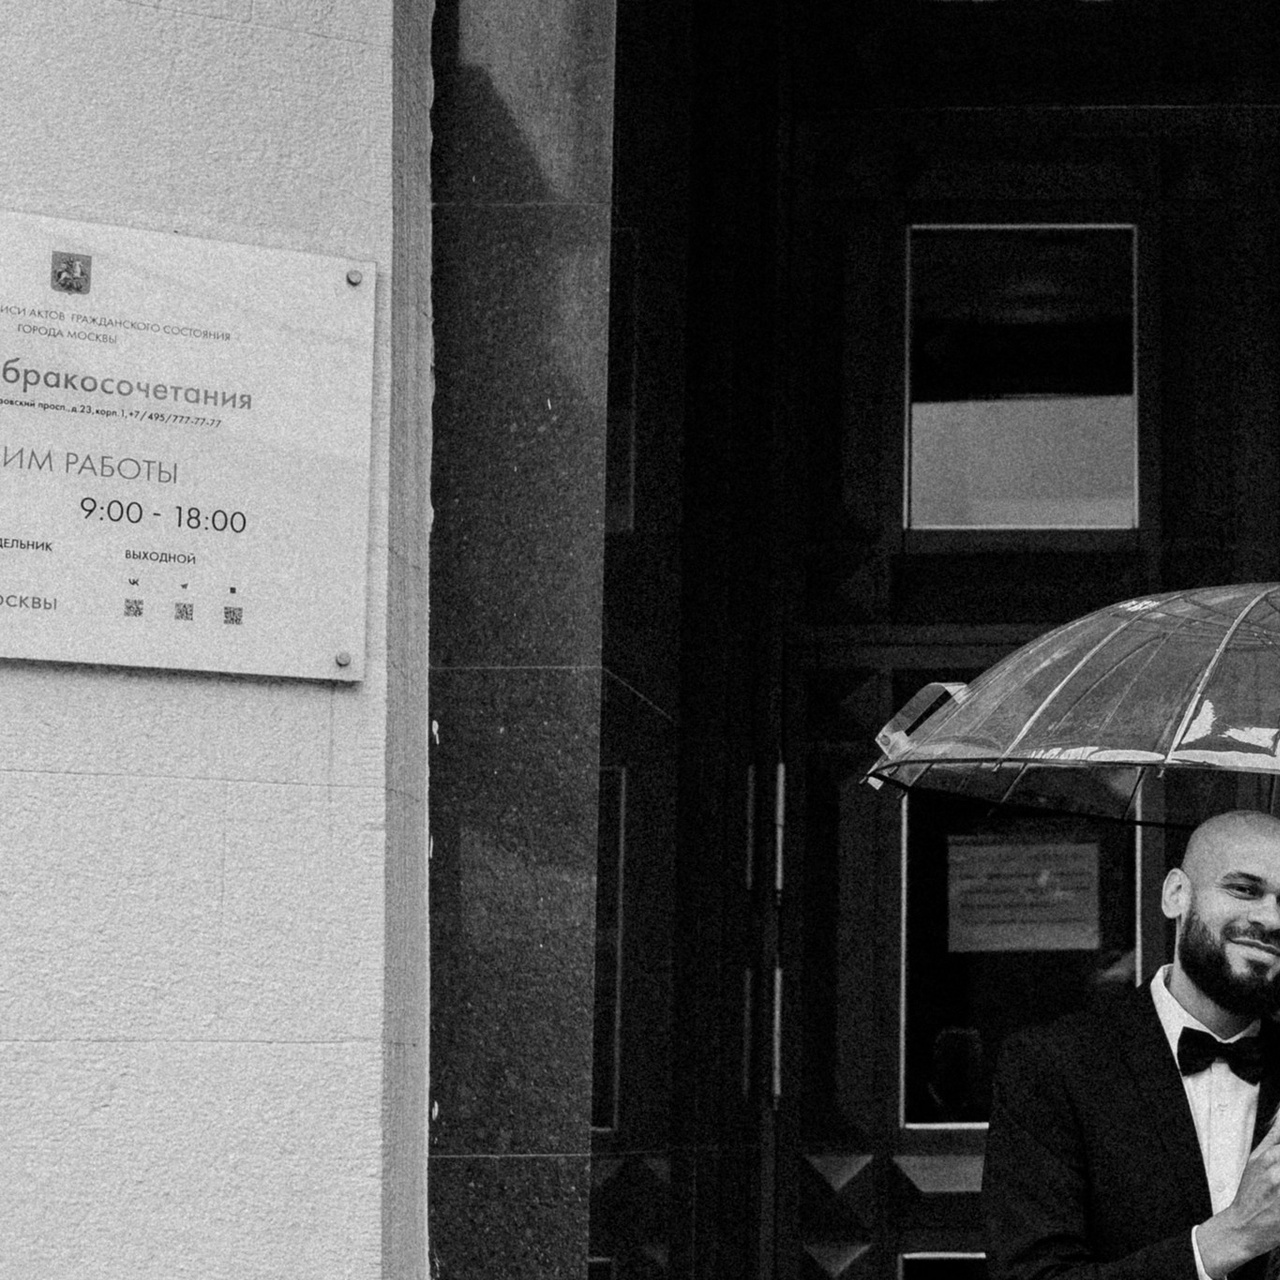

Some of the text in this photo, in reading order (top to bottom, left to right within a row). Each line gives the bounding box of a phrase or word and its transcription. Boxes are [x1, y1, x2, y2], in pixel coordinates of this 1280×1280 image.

[17, 323, 118, 344] ГОРОДА МОСКВЫ
[29, 308, 65, 321] АКТОВ
[71, 313, 161, 333] ГРАЖДАНСКОГО
[163, 324, 231, 342] СОСТОЯНИЯ
[2, 357, 252, 410] бракосочетания
[3, 445, 178, 484] ИМ РАБОТЫ
[80, 496, 143, 524] 9:00
[176, 505, 247, 534] 18:00
[125, 549, 196, 565] ВЫХОДНОЙ
